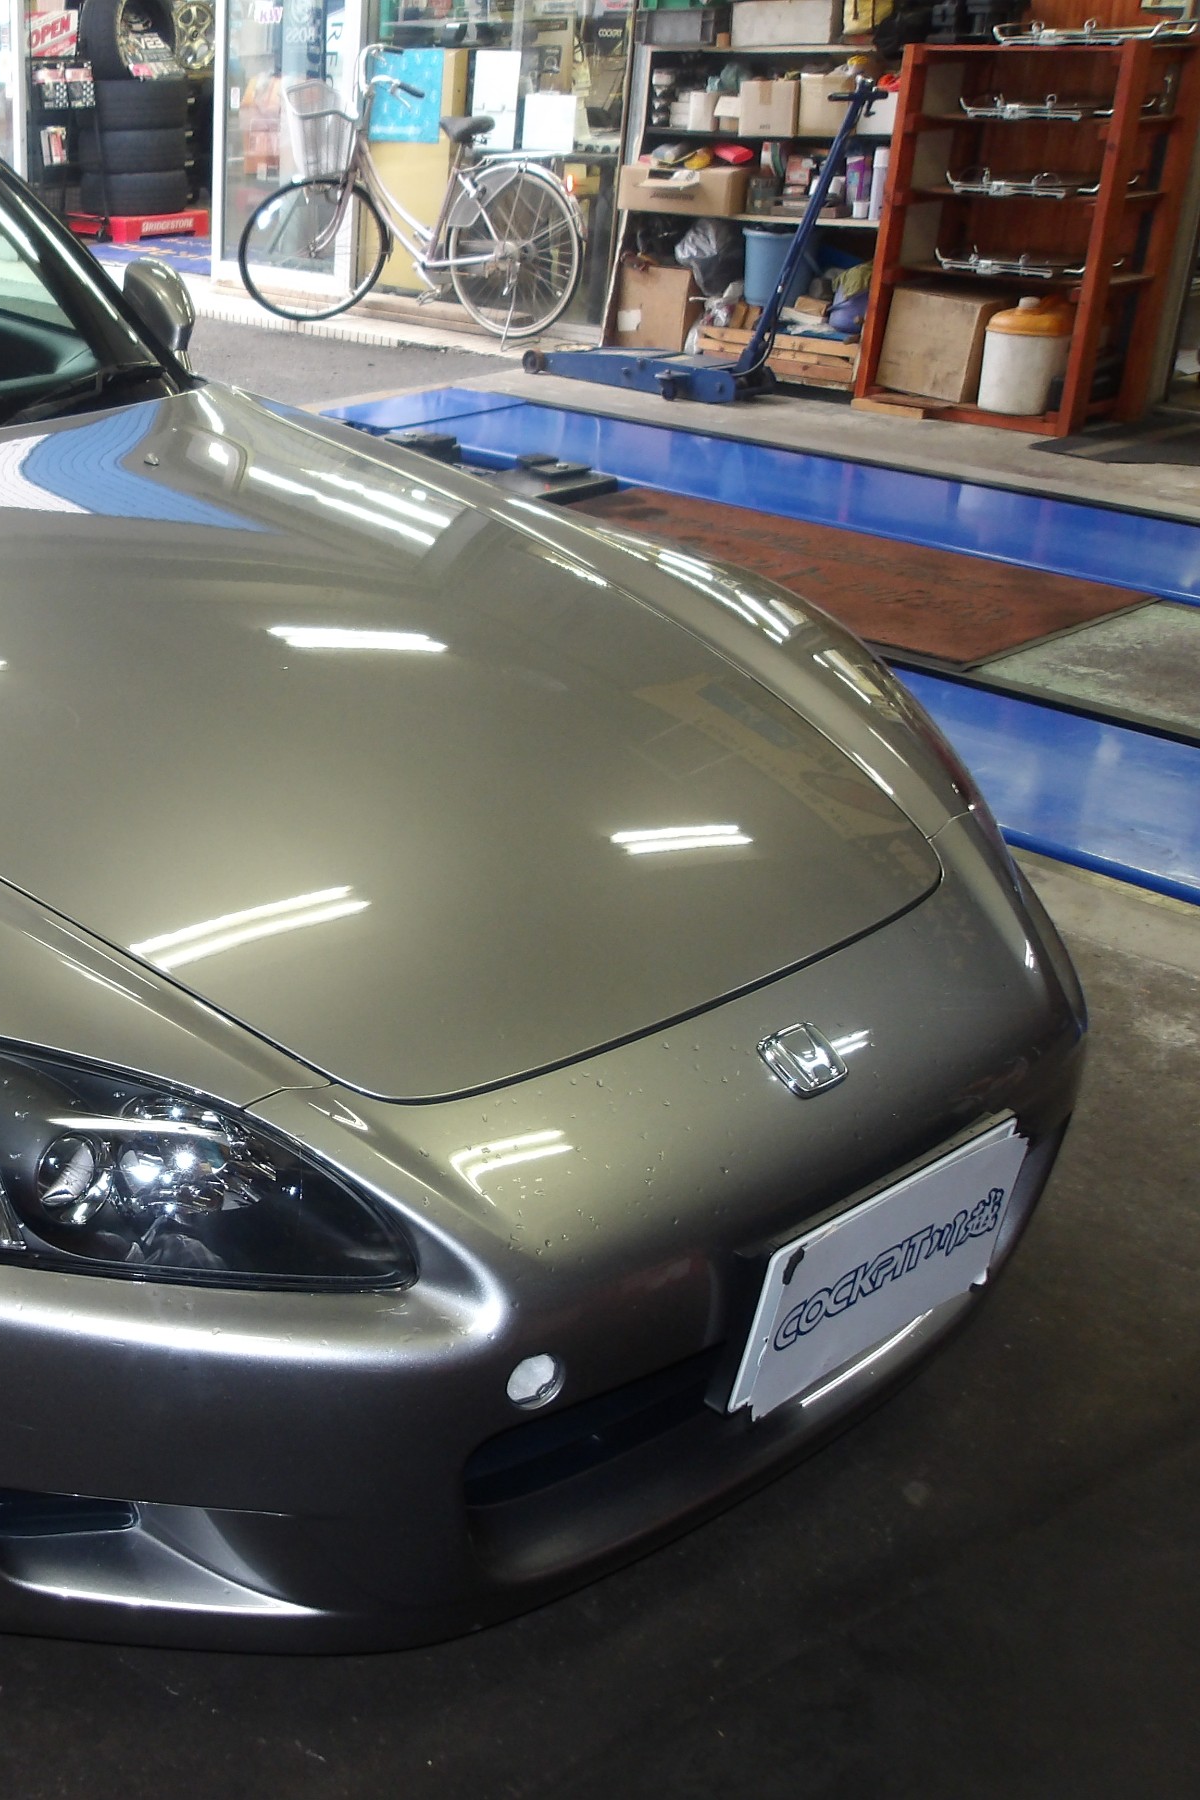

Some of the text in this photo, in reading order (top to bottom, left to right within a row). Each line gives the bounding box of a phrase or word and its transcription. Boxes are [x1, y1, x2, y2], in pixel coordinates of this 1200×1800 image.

[26, 13, 72, 49] OPEN
[141, 217, 194, 233] BRIDGESTONE
[773, 1223, 935, 1352] COCKPIT
